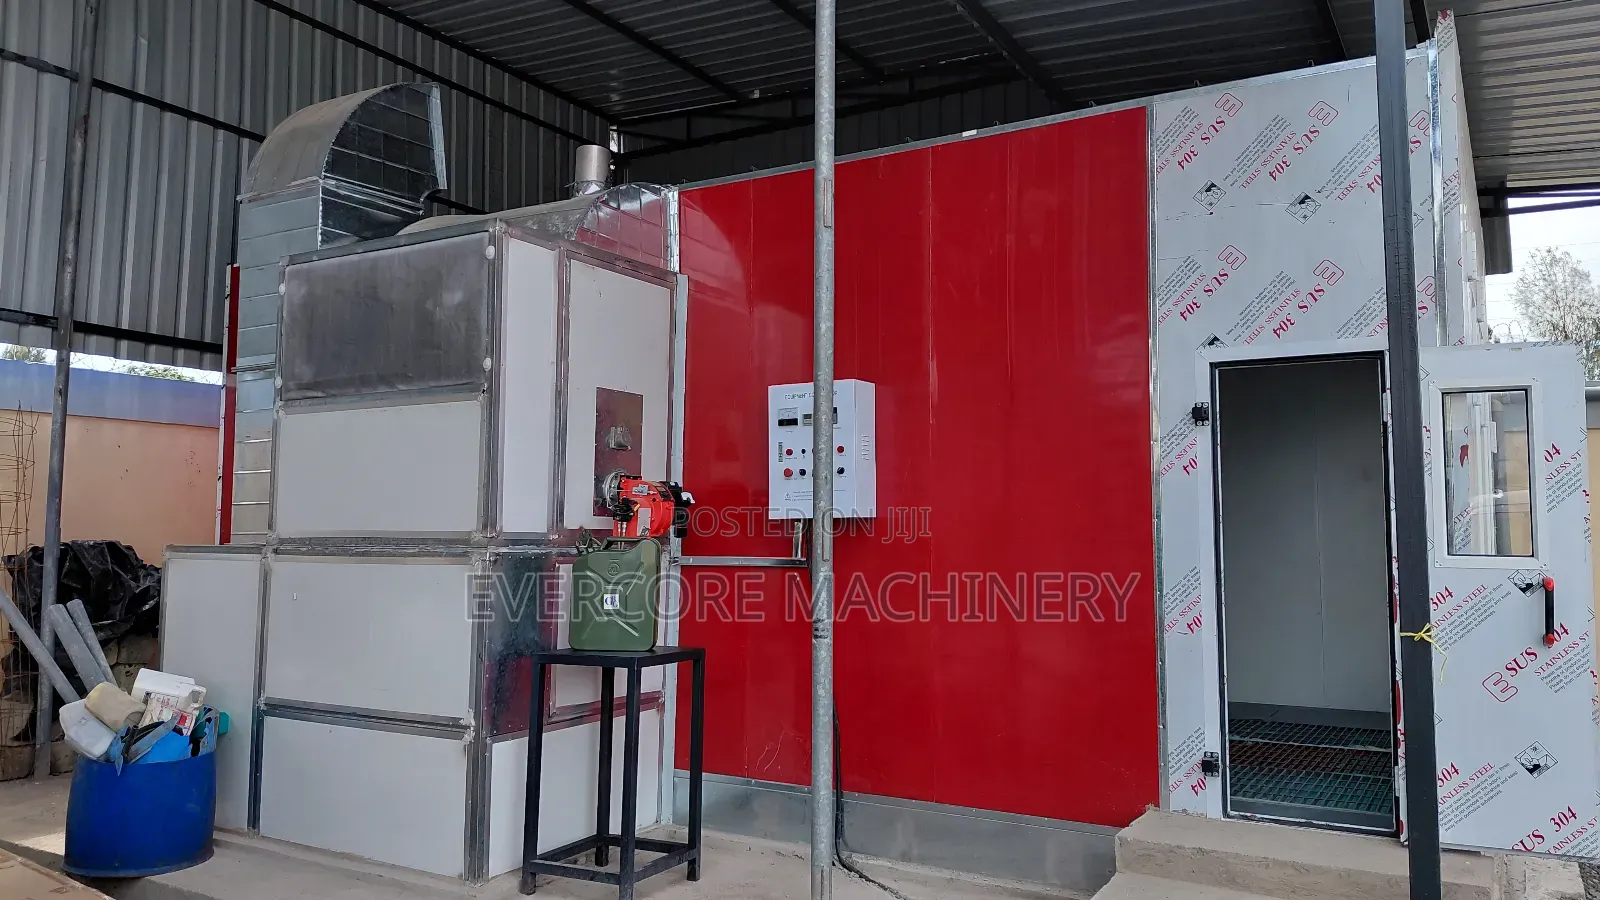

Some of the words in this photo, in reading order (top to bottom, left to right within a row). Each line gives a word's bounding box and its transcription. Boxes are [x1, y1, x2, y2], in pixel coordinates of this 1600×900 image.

[1170, 121, 1204, 158] STAINLESS
[1201, 116, 1226, 145] SUS
[1293, 124, 1320, 155] SUS
[1177, 145, 1198, 170] 304
[1261, 131, 1296, 168] STAINLESS
[1239, 168, 1261, 189] STEEL
[1268, 155, 1291, 182] 304
[1336, 178, 1359, 201] STEEL
[1367, 174, 1382, 193] 04
[1172, 273, 1206, 307] STAINLESS
[1203, 268, 1229, 297] SUS
[1180, 296, 1201, 321] 304
[1265, 288, 1301, 324] STAINLESS
[1298, 283, 1325, 314] SUS
[1242, 324, 1265, 345] STEEL
[1272, 313, 1295, 339] 304
[1544, 443, 1561, 462] 04
[1431, 585, 1454, 611] 304
[1431, 603, 1463, 631] AINLESS
[1463, 584, 1488, 605] STEEL
[1505, 647, 1538, 678] SUS
[1547, 622, 1569, 649] 04
[1534, 641, 1580, 676] STAINLESS
[1191, 774, 1206, 796] 04
[1438, 762, 1460, 787] 304
[1438, 780, 1469, 806] AINLESS
[1468, 762, 1496, 782] STEEL
[1550, 806, 1578, 833] 304
[1546, 826, 1587, 854] TAINLESS
